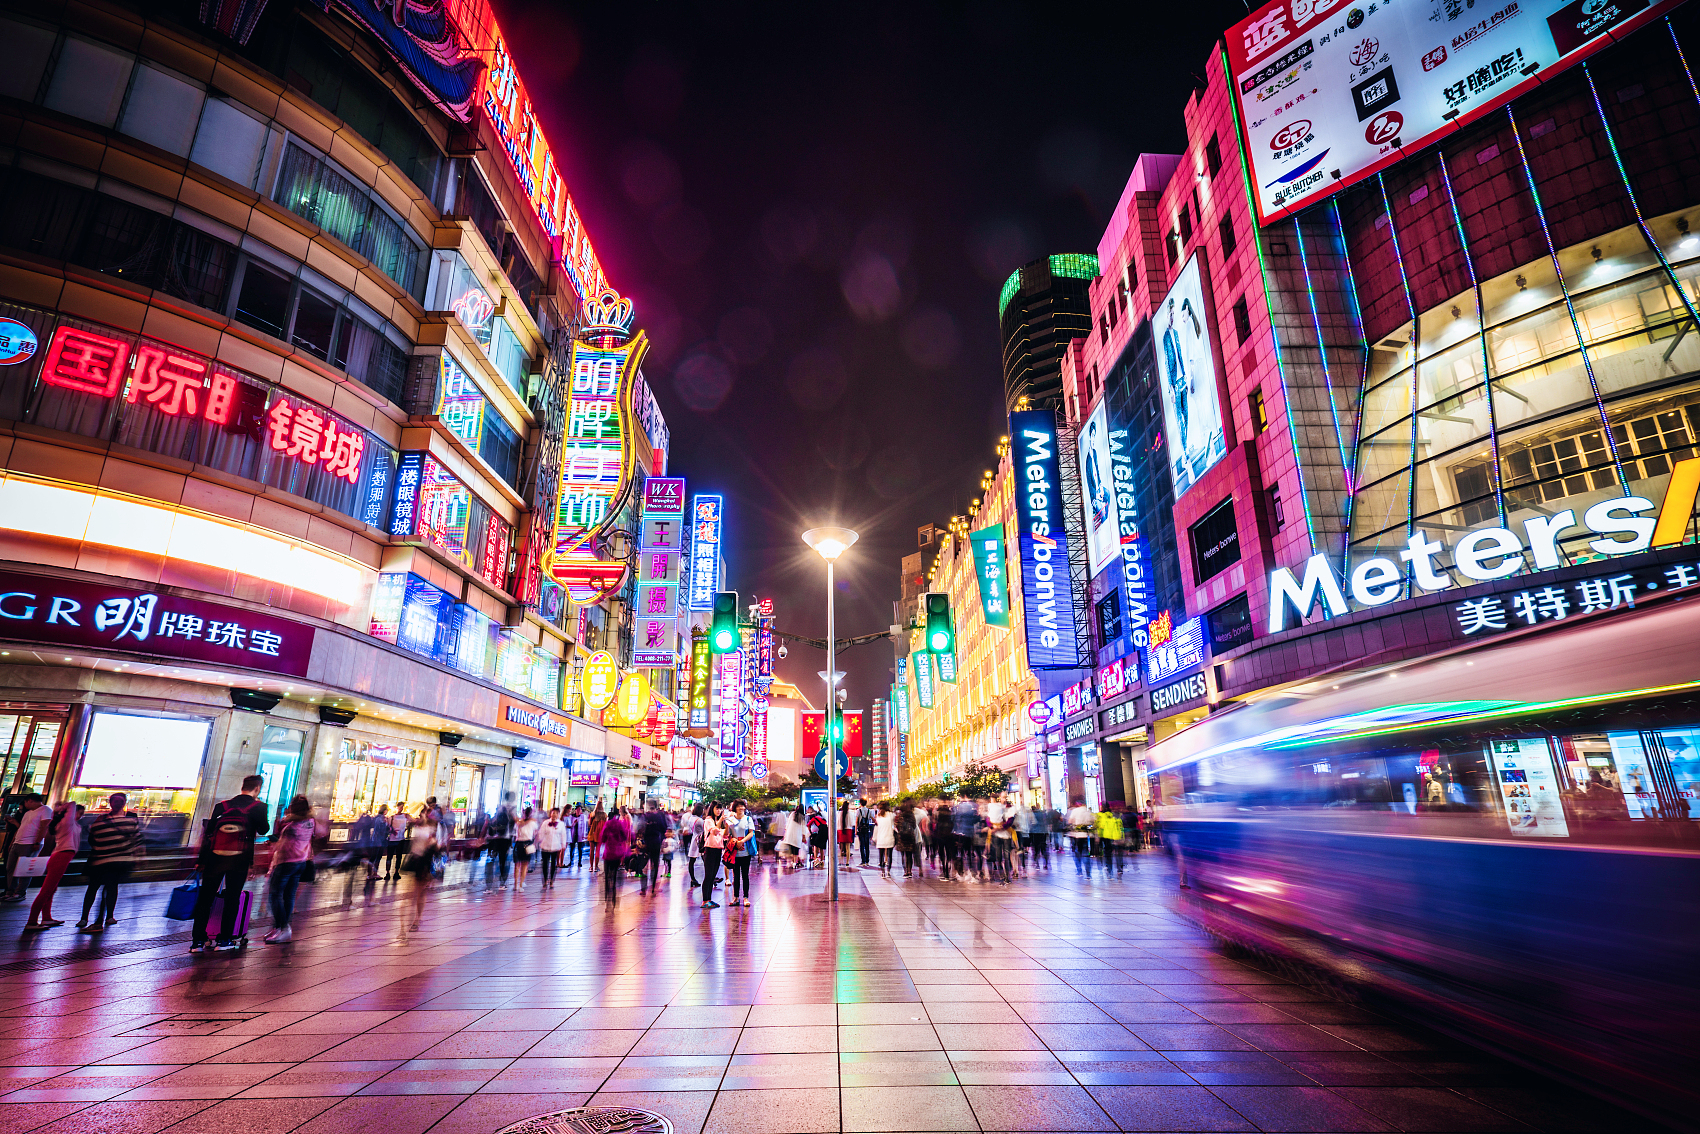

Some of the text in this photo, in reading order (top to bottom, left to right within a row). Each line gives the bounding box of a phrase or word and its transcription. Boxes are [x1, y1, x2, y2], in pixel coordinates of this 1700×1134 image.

[1275, 125, 1306, 148] GT
[485, 90, 534, 197] ZHEJIANG
[540, 203, 557, 236] SUN
[1275, 184, 1292, 200] BLUE
[1292, 170, 1324, 194] BUTCHER
[41, 325, 365, 485] 国际眼镜城
[561, 358, 618, 531] 明牌首饰
[391, 454, 420, 535] 三楼眼镜城
[651, 482, 680, 496] WK
[1024, 430, 1059, 648] Meters/bonwe
[1203, 531, 1237, 561] Meters/bonwe
[380, 574, 405, 585] 手机
[646, 521, 671, 648] 王開摄影
[95, 593, 283, 657] 明牌珠宝
[1215, 622, 1251, 643] Meters/bonwe
[693, 654, 708, 709] 美食广场
[1152, 673, 1207, 711] SENDNES
[508, 706, 540, 729] MINGR
[1066, 717, 1094, 741] SENDNES
[675, 748, 692, 758] UNI
